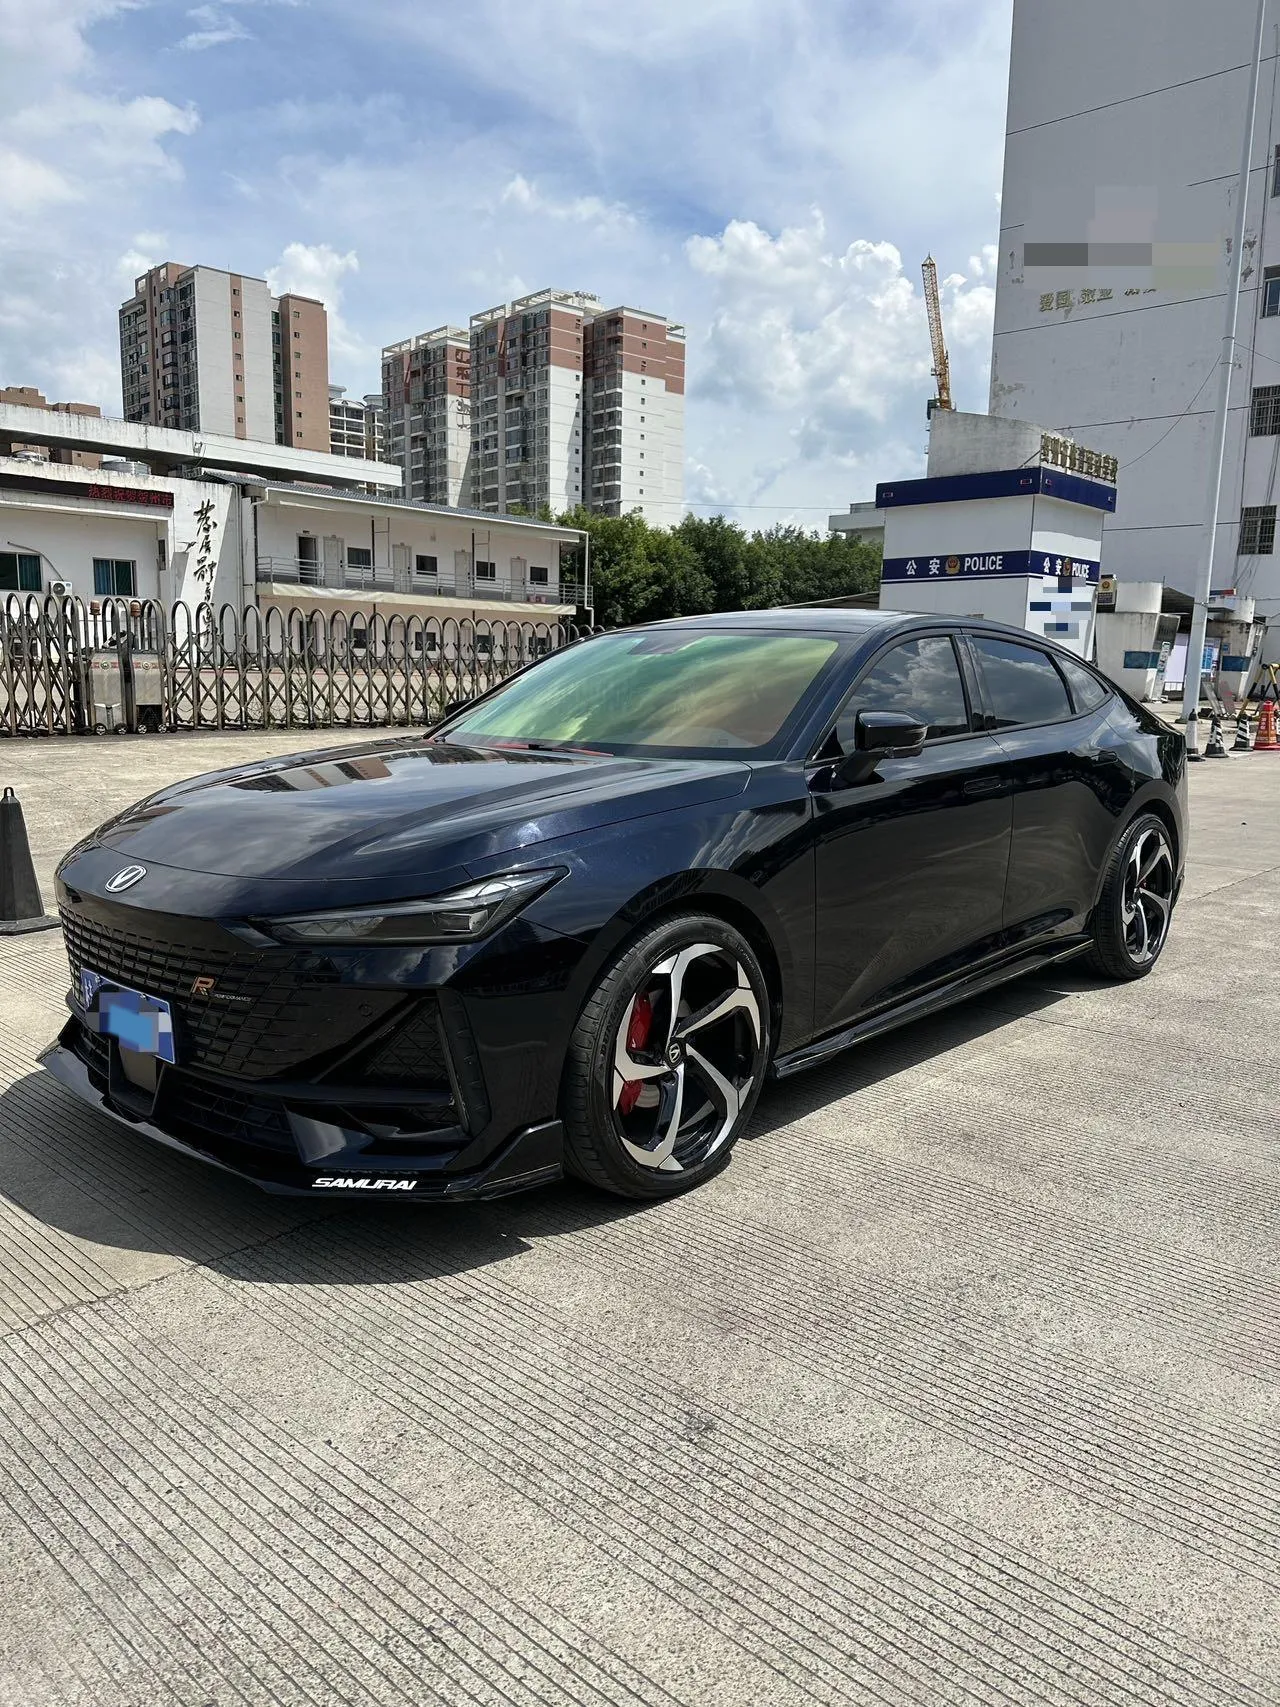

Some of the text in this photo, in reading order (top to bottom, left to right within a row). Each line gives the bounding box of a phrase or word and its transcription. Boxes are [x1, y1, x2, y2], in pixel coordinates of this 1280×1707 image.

[905, 556, 1003, 575] 公安 POLICE
[1043, 557, 1090, 578] 公安 POLICE
[191, 975, 217, 996] R
[311, 1177, 418, 1191] SAMURAI
